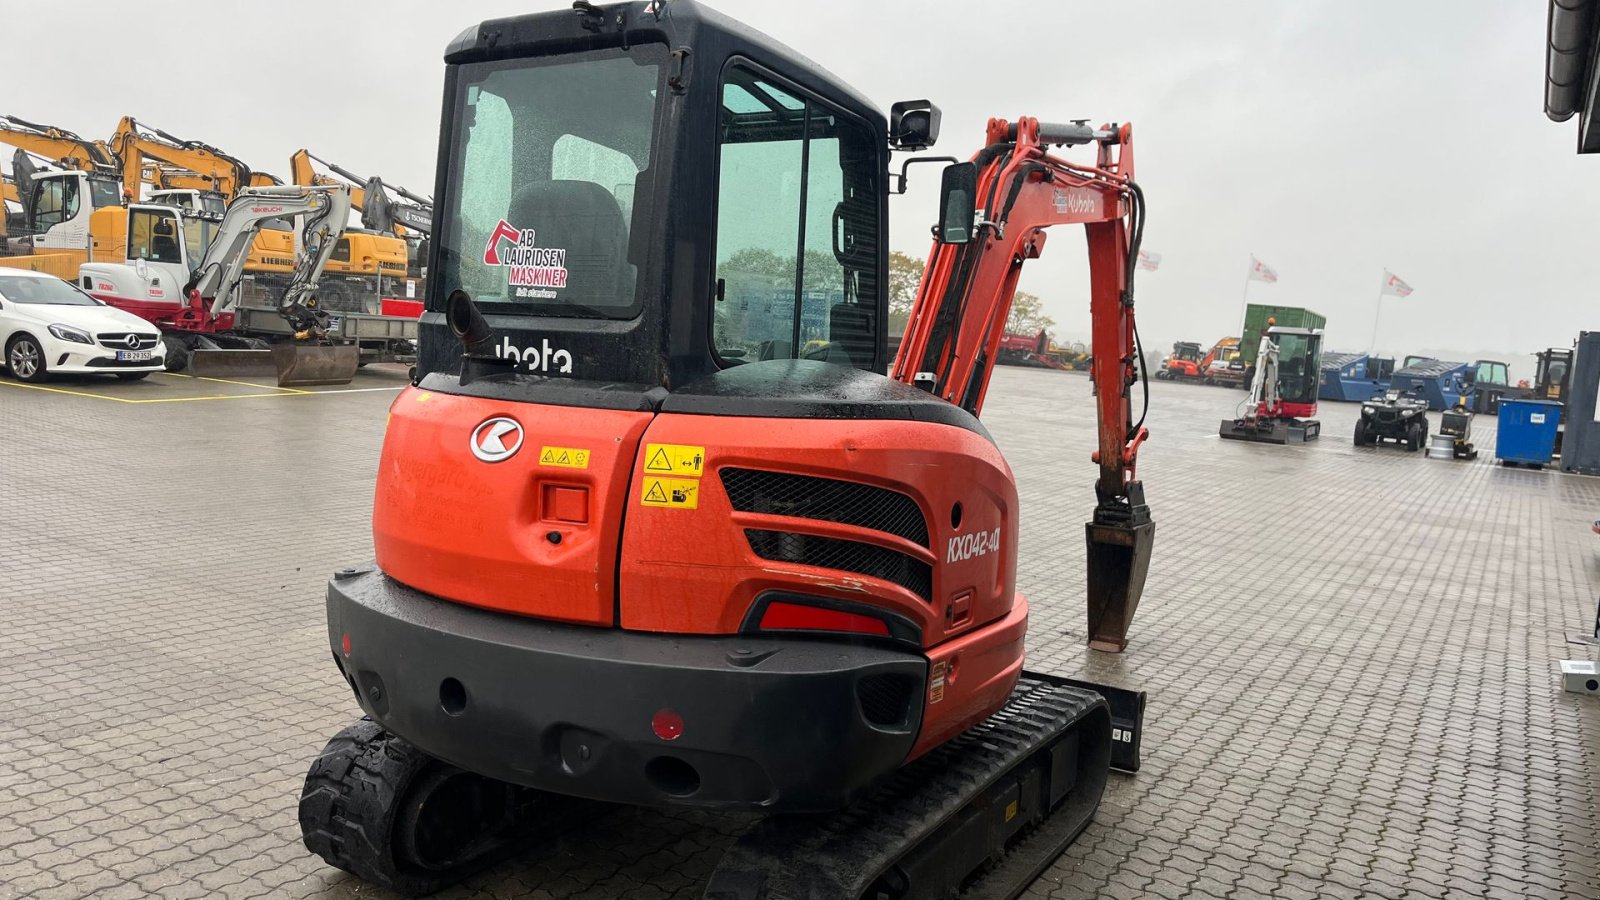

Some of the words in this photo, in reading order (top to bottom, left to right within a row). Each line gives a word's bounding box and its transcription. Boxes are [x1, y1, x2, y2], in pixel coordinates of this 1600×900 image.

[1068, 193, 1095, 214] Kubota
[518, 230, 535, 247] AB
[504, 249, 565, 266] LAURIDSEN
[509, 267, 567, 287] MASKINER
